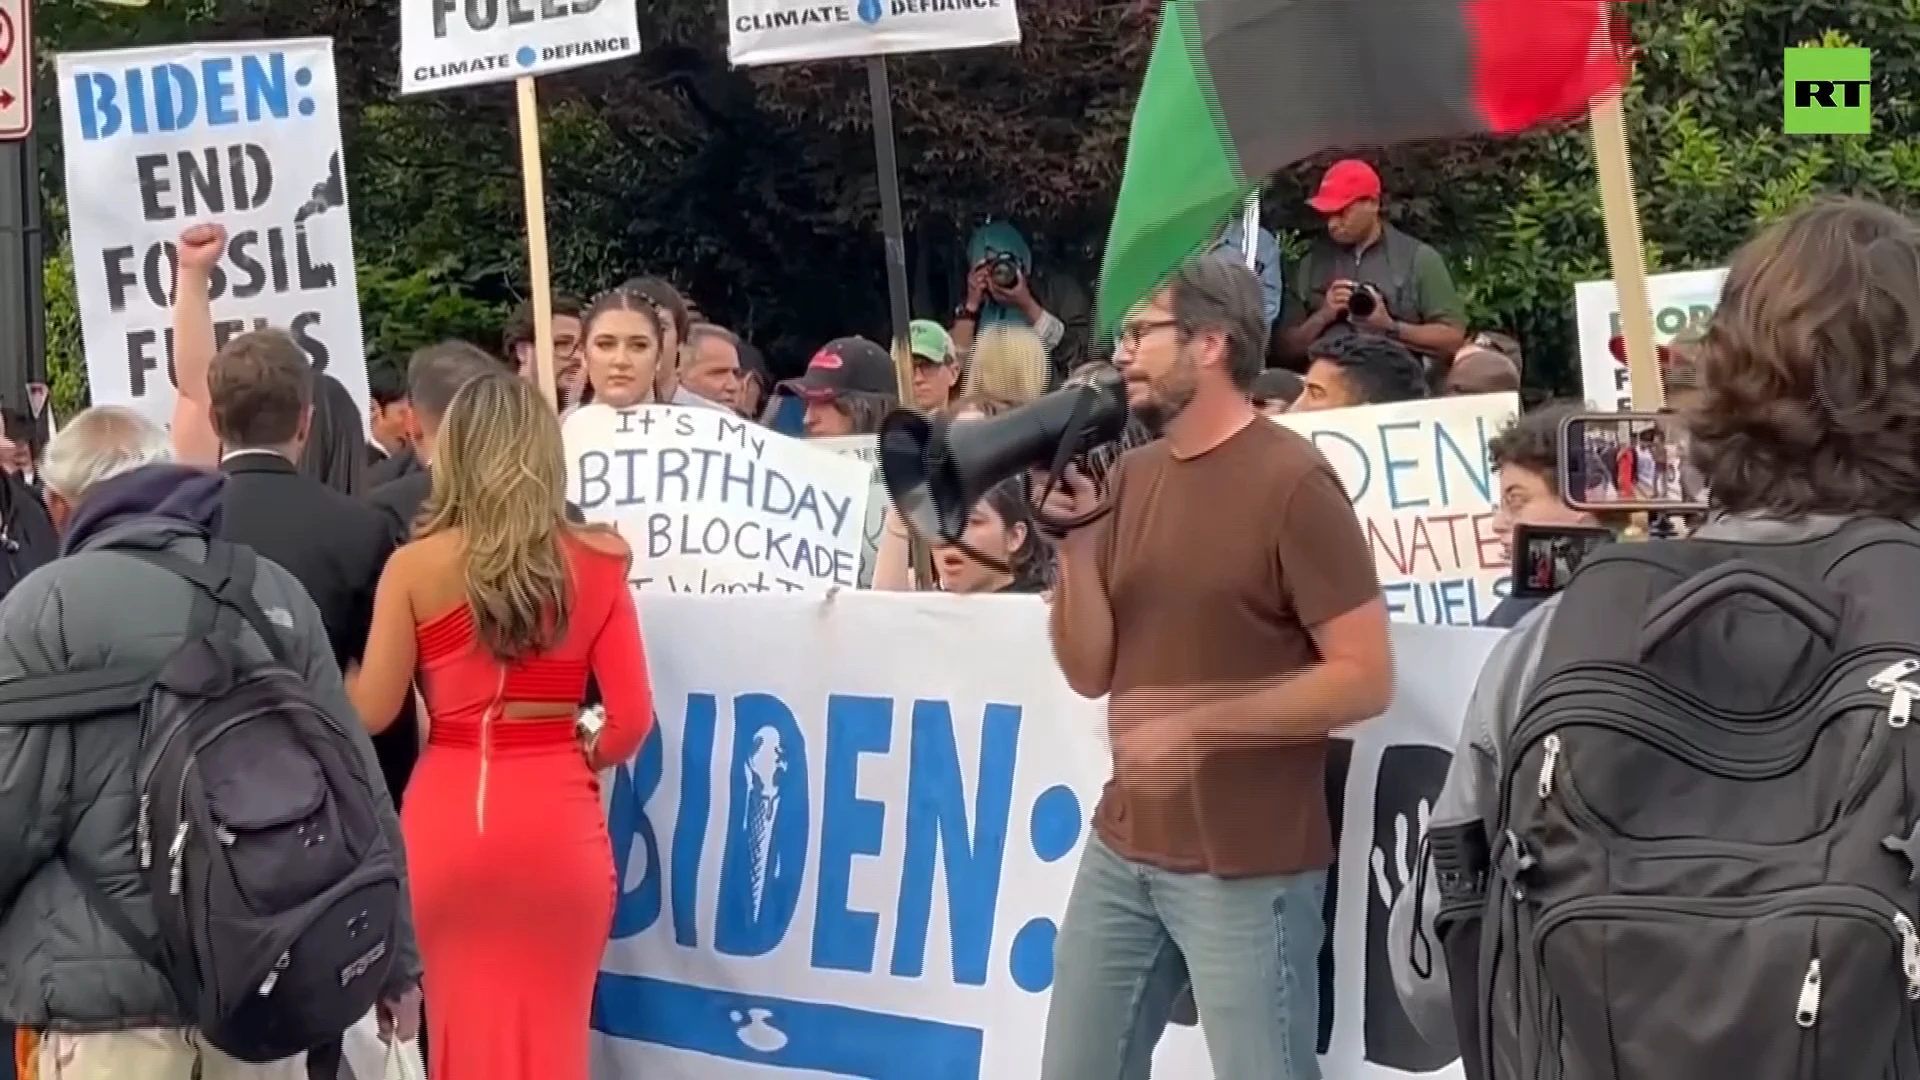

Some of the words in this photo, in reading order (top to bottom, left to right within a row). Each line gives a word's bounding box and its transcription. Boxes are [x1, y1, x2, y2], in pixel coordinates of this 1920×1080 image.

[735, 5, 850, 33] CLIMATE
[74, 52, 315, 140] BIDEN:
[414, 54, 509, 81] CLIMATE
[542, 37, 630, 61] DEFIANCE
[136, 143, 273, 221] END
[578, 448, 852, 536] BIRTHDAY
[648, 513, 853, 586] BLOCKADE
[608, 692, 1083, 992] BIDEN:
